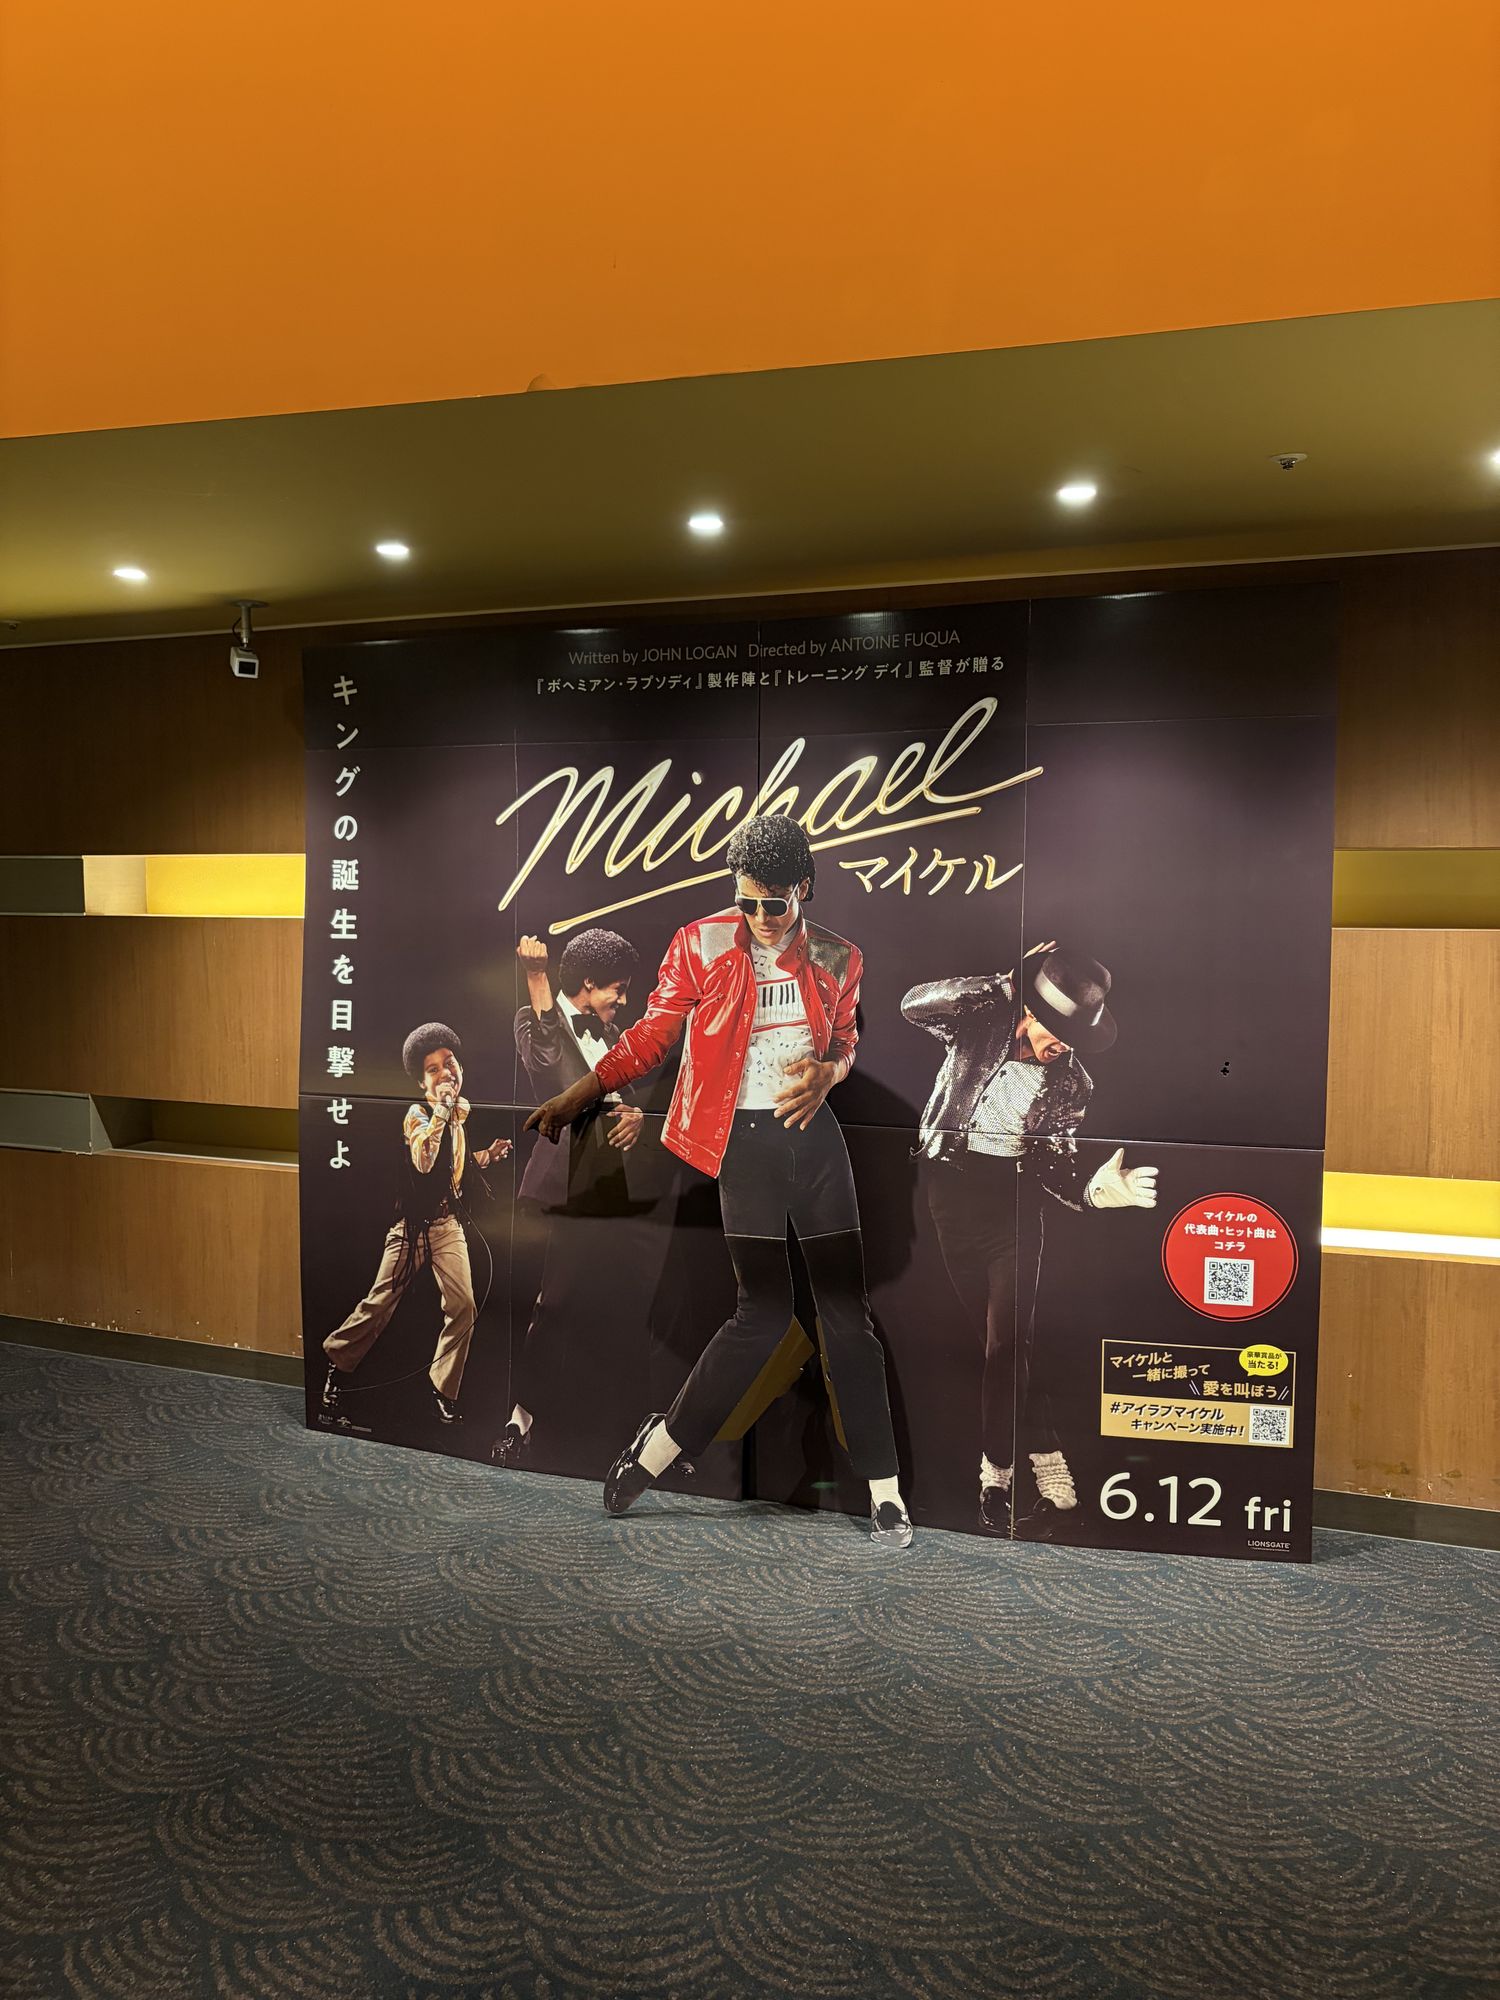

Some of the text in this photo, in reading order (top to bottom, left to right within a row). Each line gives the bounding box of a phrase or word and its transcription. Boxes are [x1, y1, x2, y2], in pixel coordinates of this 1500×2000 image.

[568, 629, 961, 666] Written by JOHN LOGAN Directed by ANTOINE FUQUA
[495, 696, 1044, 912] Michael
[838, 846, 1024, 896] マイケル
[326, 674, 361, 1171] キングの誕生を目撃せよ
[1203, 1210, 1258, 1223] マイケルの
[1184, 1223, 1277, 1239] 代表曲・ヒット曲は
[1214, 1241, 1246, 1252] コチラ
[1109, 1351, 1173, 1369] マイケルと
[1132, 1364, 1211, 1382] 一緒に撮って
[1202, 1380, 1279, 1399] 愛を叫ぼう
[1099, 1471, 1292, 1533] 6.12 fri
[1247, 1540, 1290, 1549] LIONSGATE
